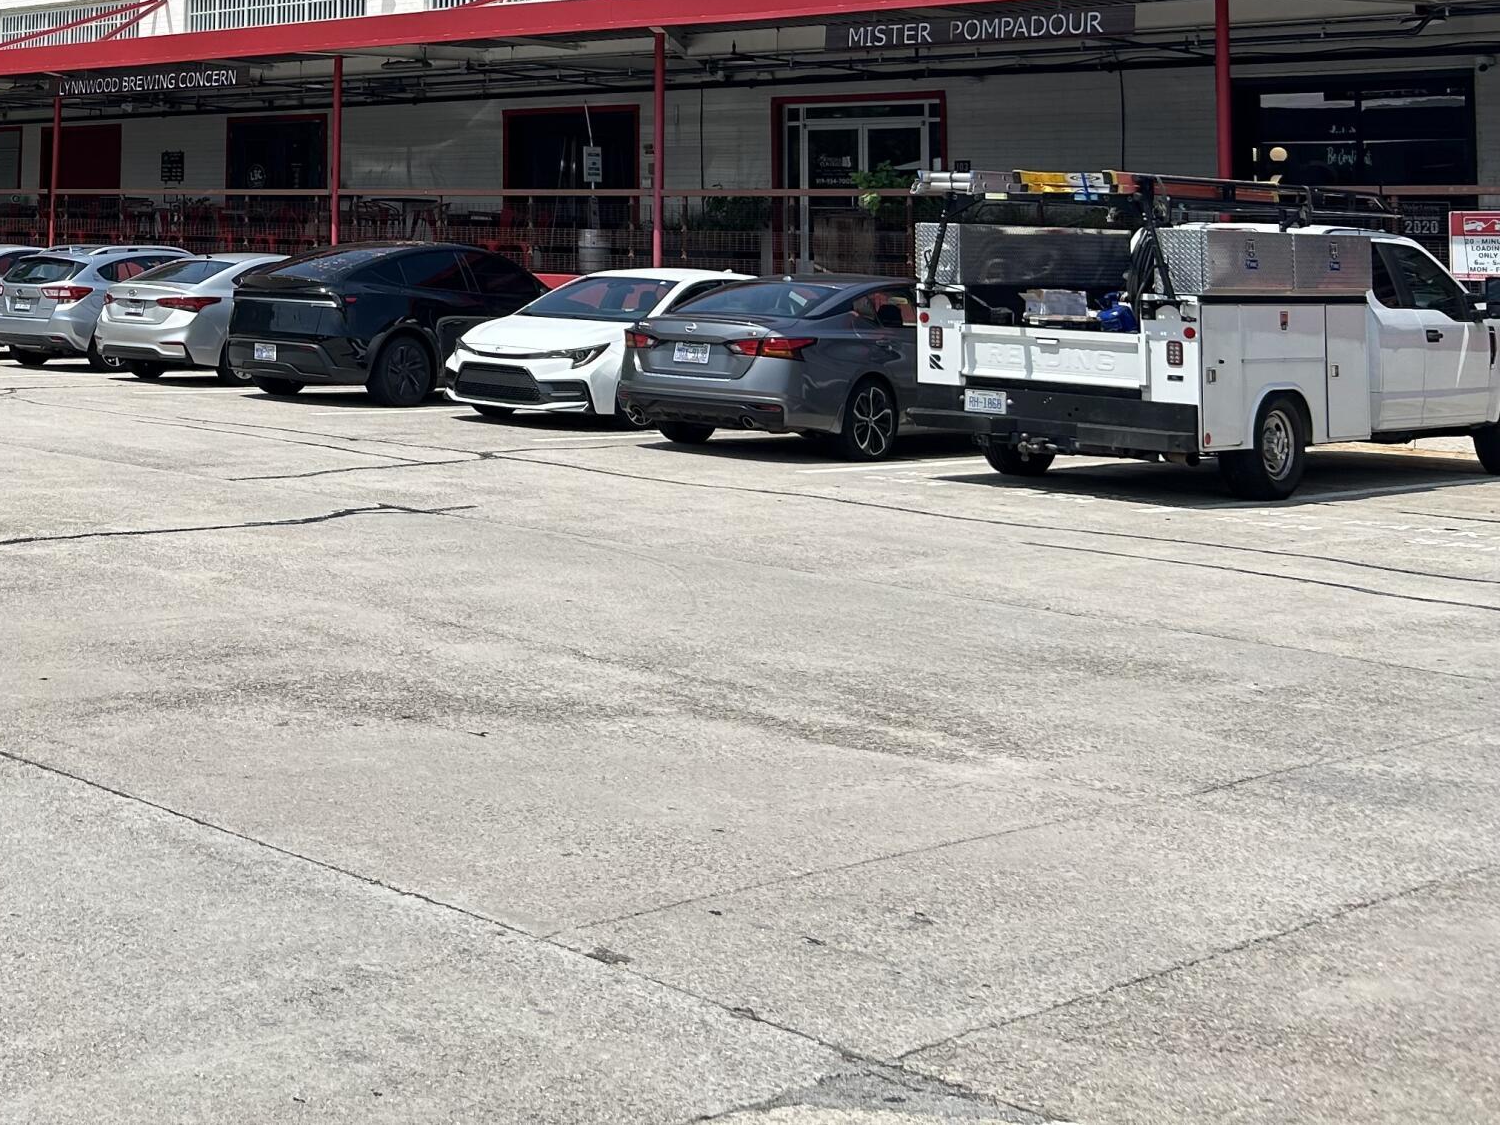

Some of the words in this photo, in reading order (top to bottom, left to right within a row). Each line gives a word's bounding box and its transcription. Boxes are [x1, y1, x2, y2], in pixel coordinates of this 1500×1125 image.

[848, 22, 932, 47] MISTER
[949, 11, 1103, 41] POMPADOUR
[59, 77, 119, 96] LYNNWOOD
[121, 73, 176, 92] BREWING
[179, 69, 237, 88] CONCERN
[1404, 220, 1440, 234] 2020
